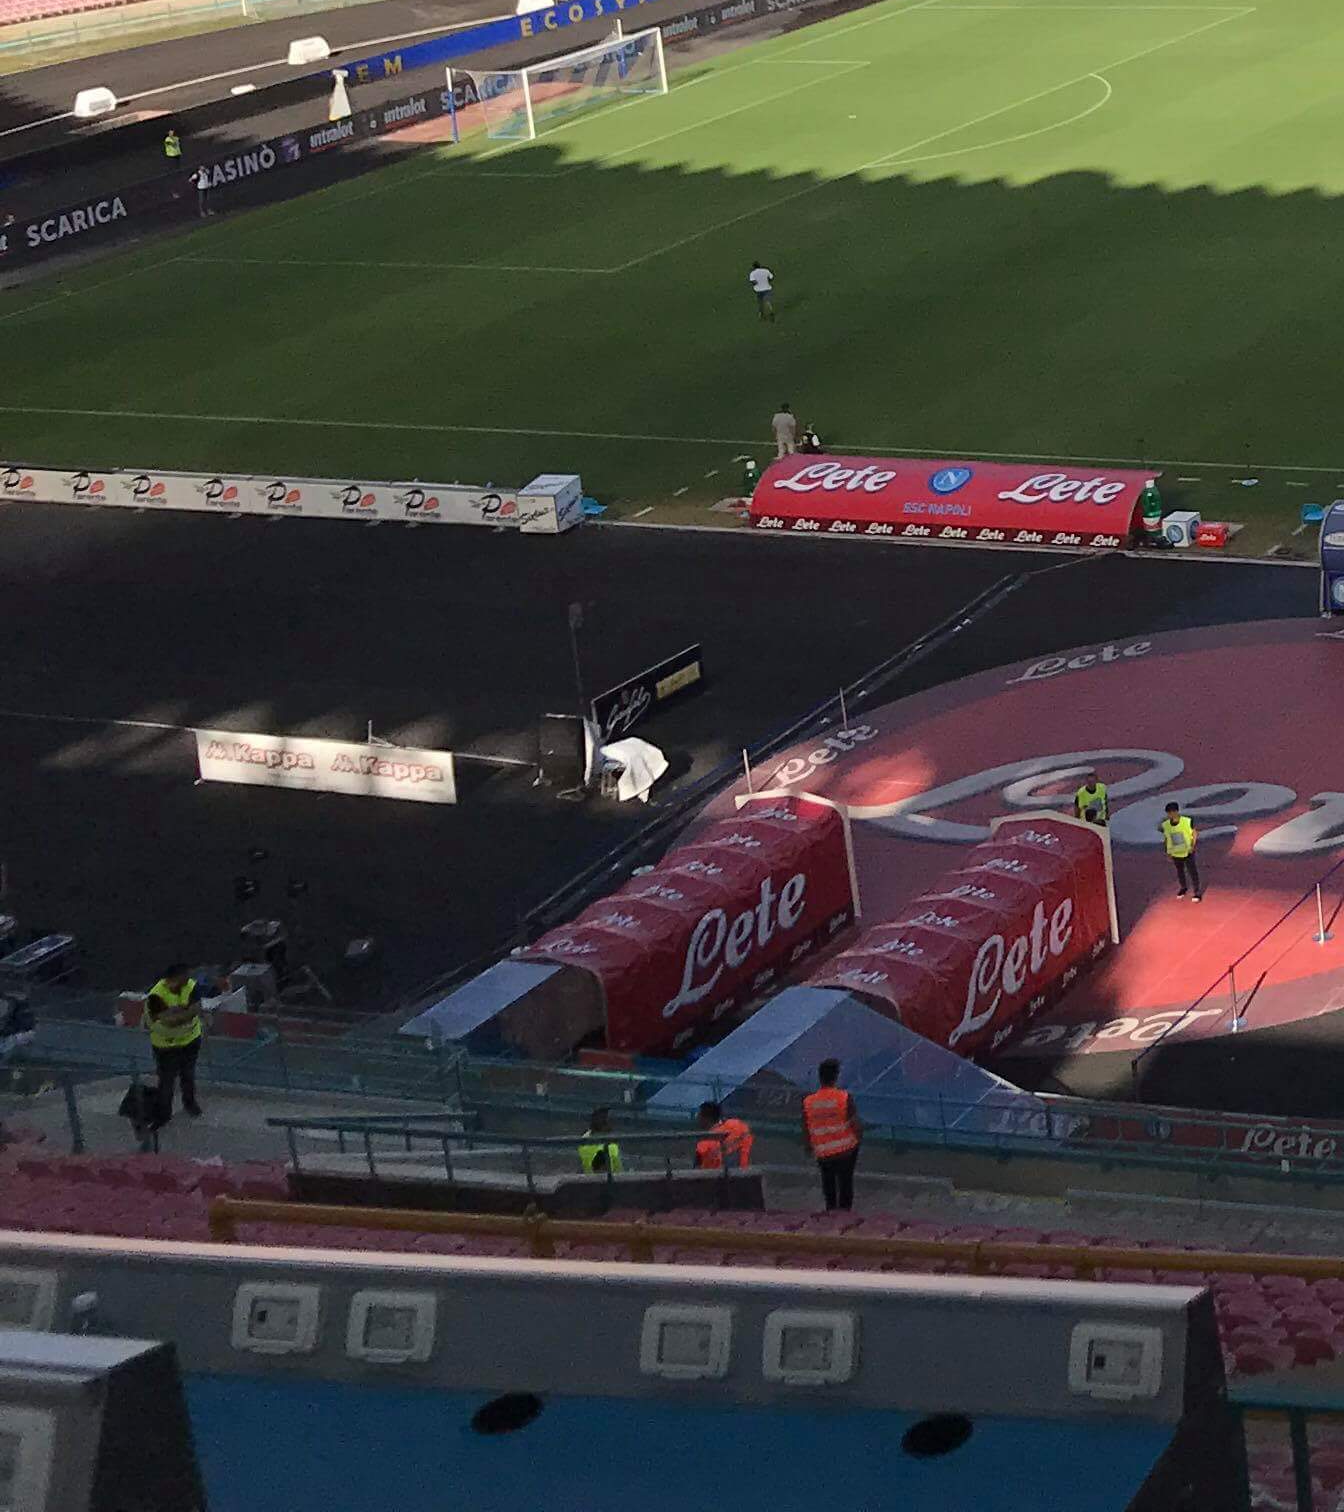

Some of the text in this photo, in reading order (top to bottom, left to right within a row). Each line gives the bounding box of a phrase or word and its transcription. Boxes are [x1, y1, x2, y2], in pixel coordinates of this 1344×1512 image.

[27, 196, 127, 247] SCARICA
[774, 461, 898, 493] Lete
[997, 472, 1128, 505] Lete
[928, 503, 973, 517] NAPOLI
[757, 516, 1120, 548] Lete Lete Lete Lete Lete Lete Lete Lete Lete Lete
[1006, 641, 1153, 684] Lete
[234, 744, 315, 771] Kappa
[360, 755, 444, 782] Kappa
[662, 873, 806, 1019] Lete
[948, 896, 1073, 1046] Lete
[1240, 1122, 1338, 1161] Lete
